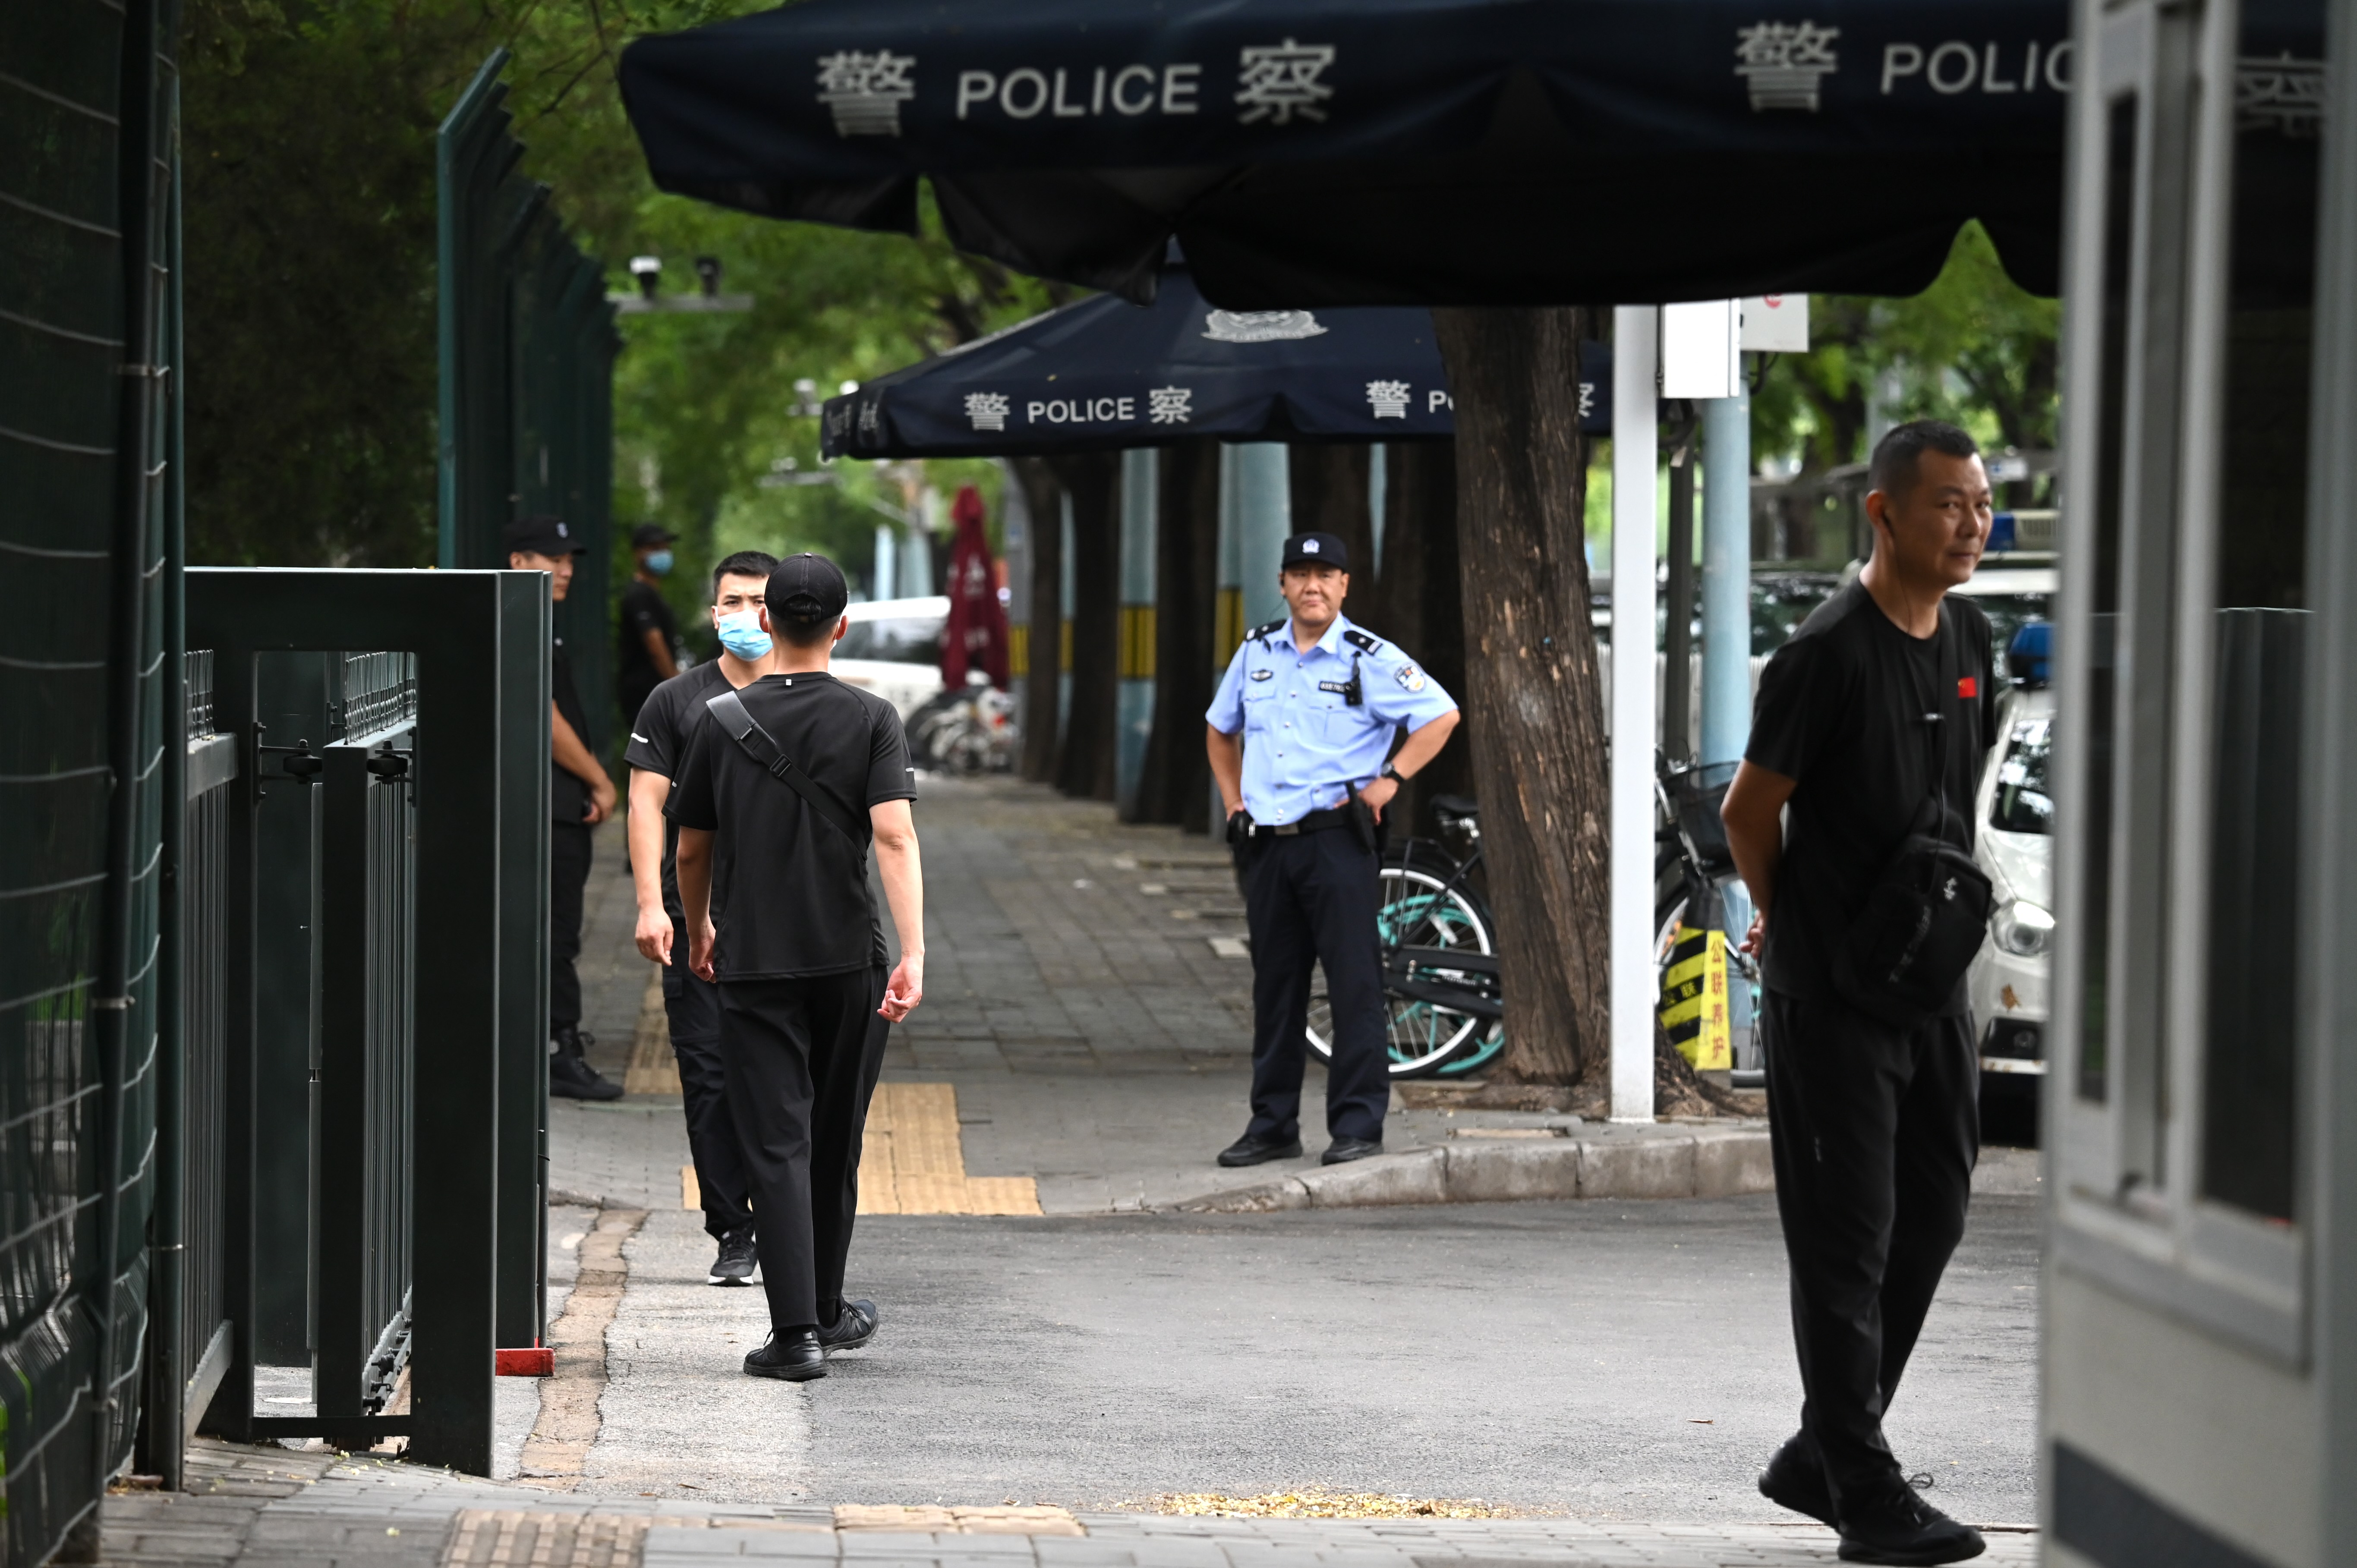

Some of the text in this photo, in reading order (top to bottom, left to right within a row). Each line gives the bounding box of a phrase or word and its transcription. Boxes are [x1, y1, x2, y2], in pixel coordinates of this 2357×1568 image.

[817, 38, 1335, 136] 警 POLICE 察
[1735, 21, 1839, 111] 警
[1881, 40, 2077, 95] POLIC
[964, 385, 1193, 431] 警 POLICE 察
[1366, 379, 1411, 419] 警
